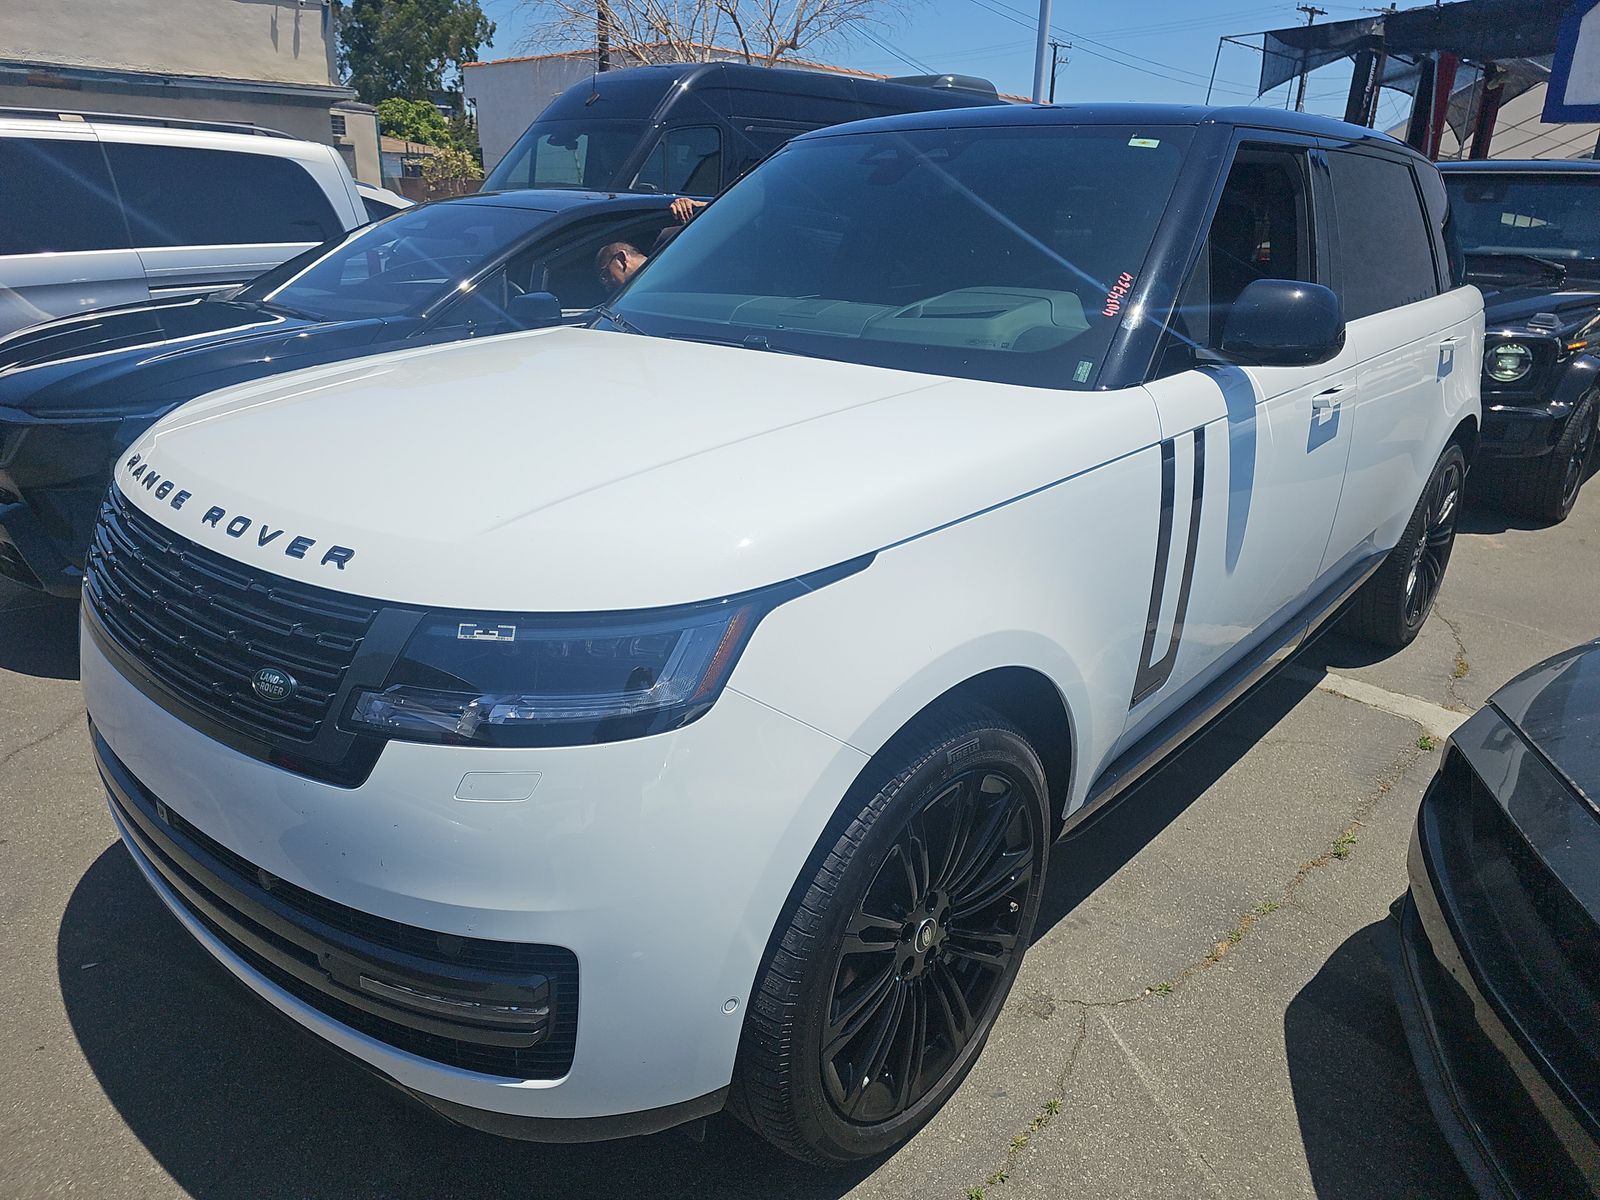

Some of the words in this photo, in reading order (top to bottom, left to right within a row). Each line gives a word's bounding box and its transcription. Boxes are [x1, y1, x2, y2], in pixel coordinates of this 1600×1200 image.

[126, 453, 193, 511] RANGE
[201, 506, 356, 570] ROVER
[259, 681, 284, 696] ROVER
